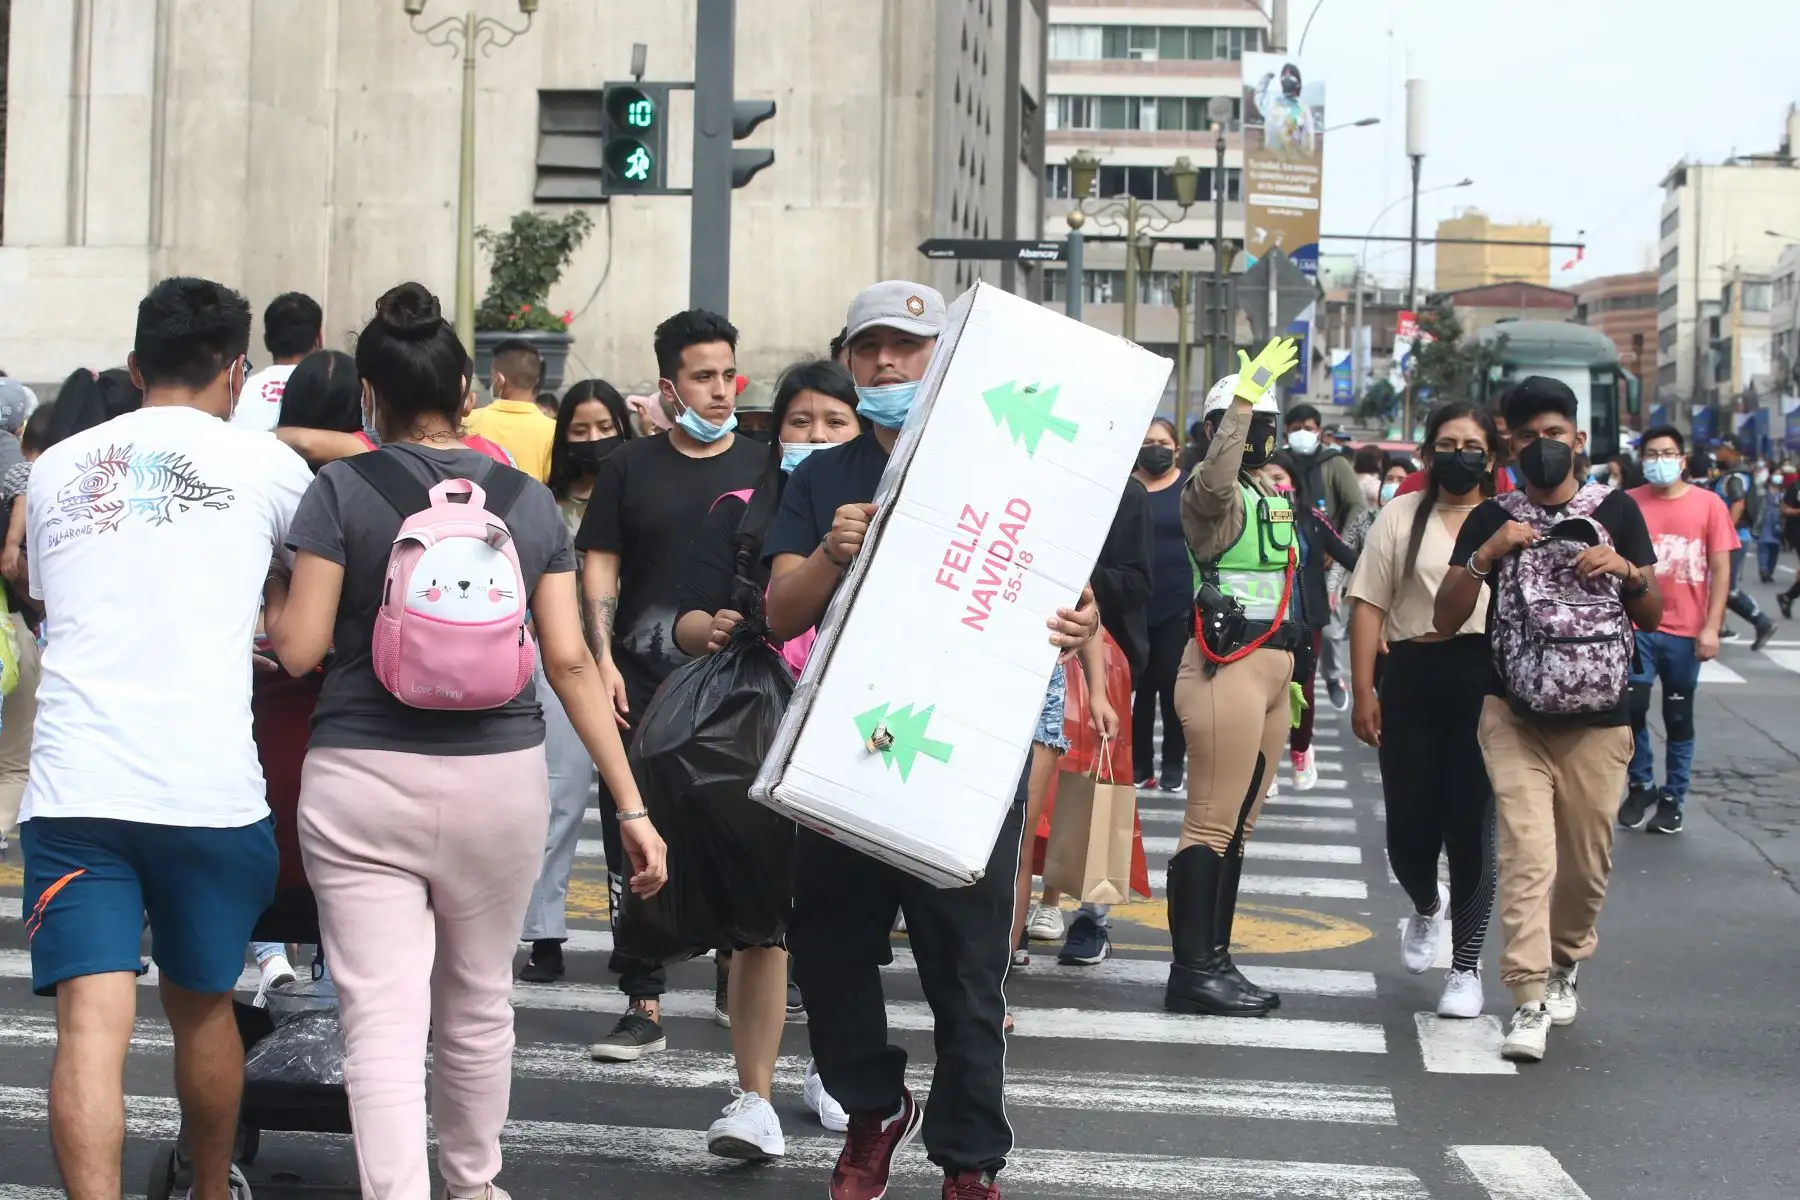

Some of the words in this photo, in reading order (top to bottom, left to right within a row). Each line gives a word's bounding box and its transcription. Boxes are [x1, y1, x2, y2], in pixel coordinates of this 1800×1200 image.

[629, 101, 651, 127] 10
[1019, 248, 1059, 260] Abancay
[935, 503, 989, 591] FELIZ
[961, 498, 1031, 631] NAVIDAD
[1002, 550, 1033, 603] 55-18
[411, 680, 432, 695] Love
